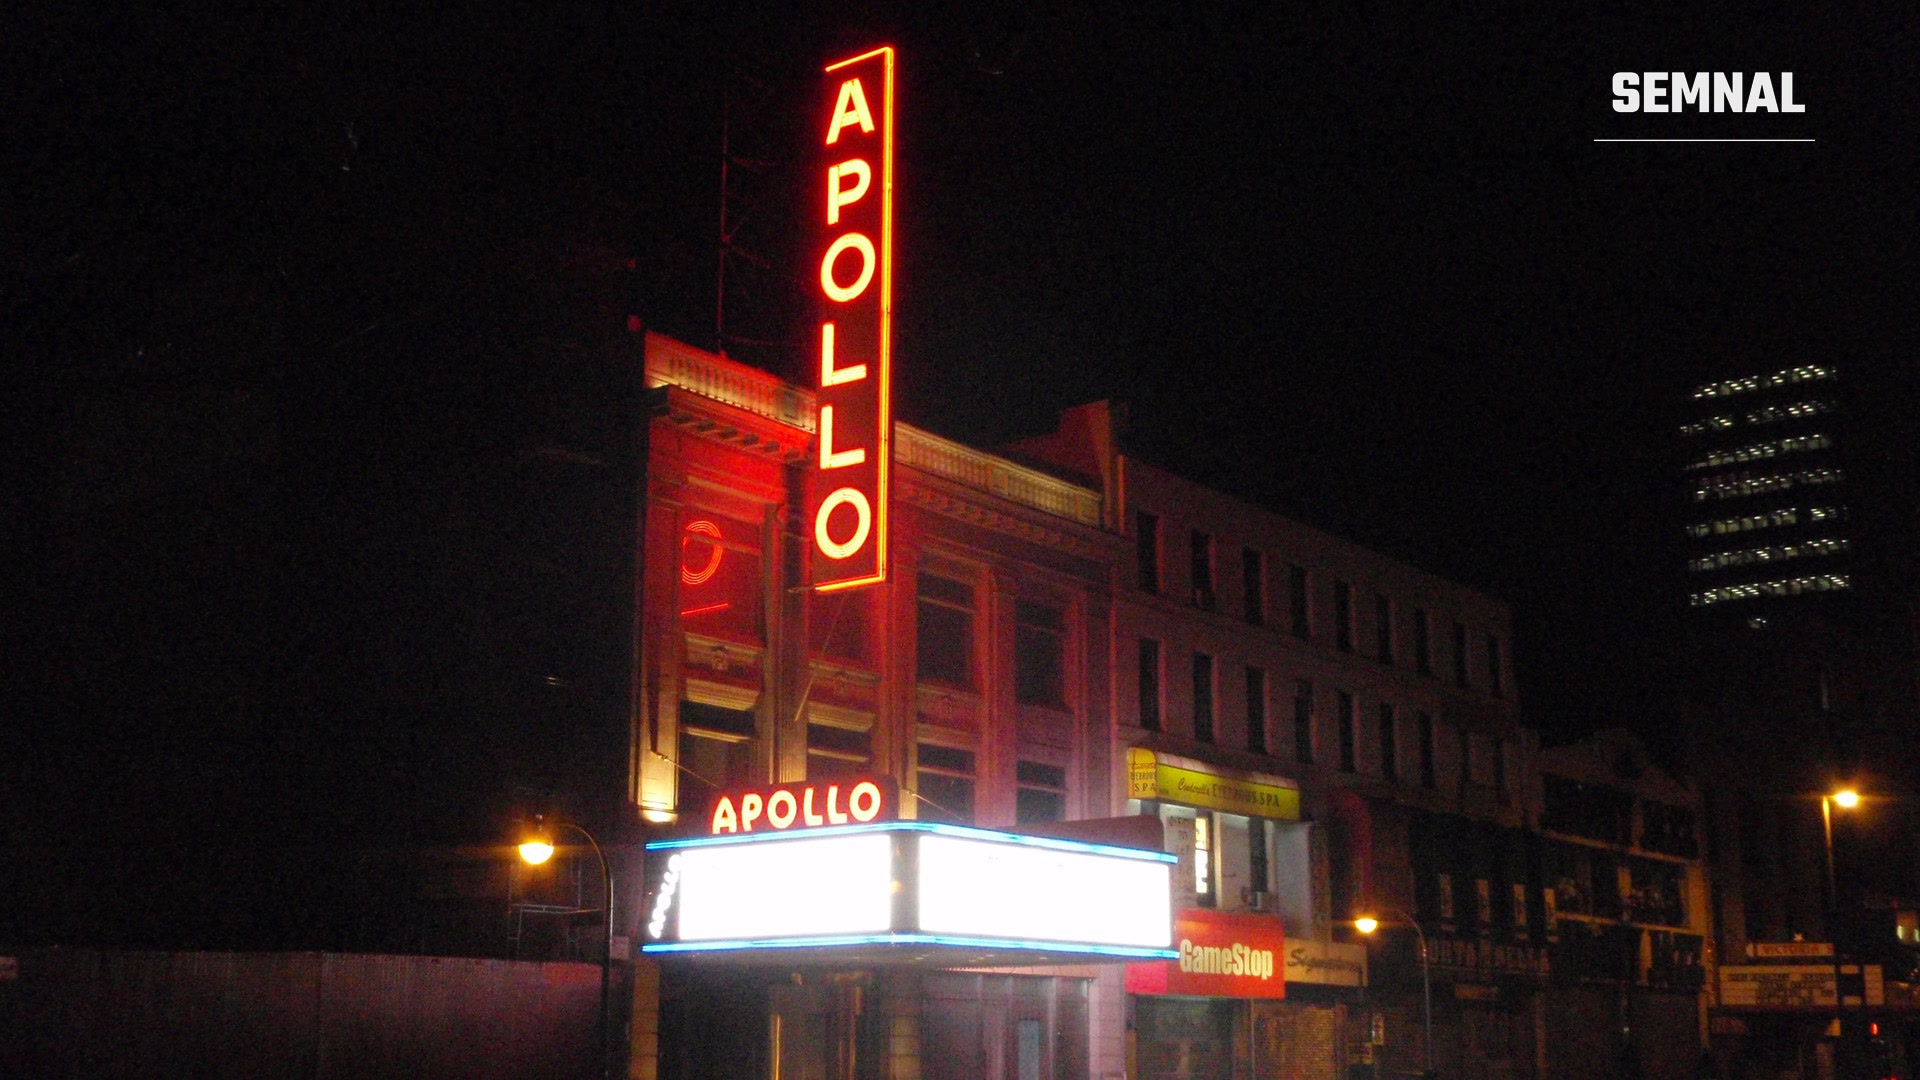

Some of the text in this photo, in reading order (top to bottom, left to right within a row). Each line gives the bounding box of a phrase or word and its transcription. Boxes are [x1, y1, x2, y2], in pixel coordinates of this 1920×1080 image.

[815, 78, 875, 559] APOLLO
[712, 782, 881, 834] APOLLO
[1260, 792, 1280, 807] SPA
[1180, 939, 1273, 980] GameStop
